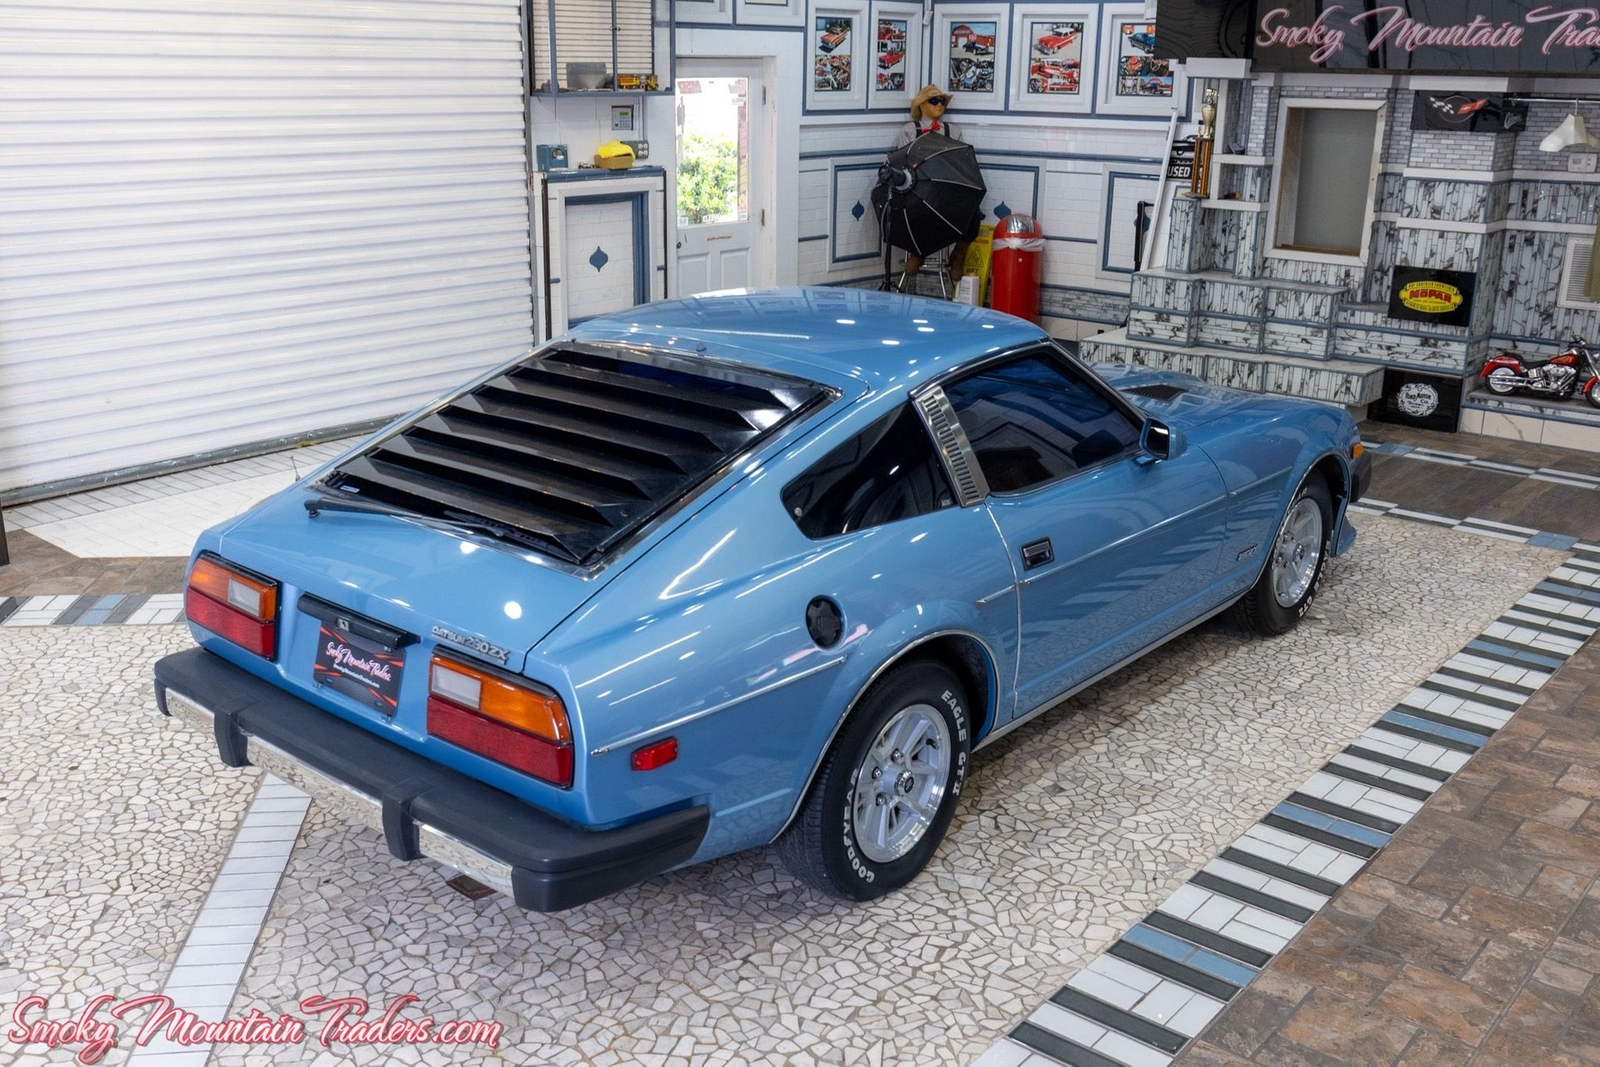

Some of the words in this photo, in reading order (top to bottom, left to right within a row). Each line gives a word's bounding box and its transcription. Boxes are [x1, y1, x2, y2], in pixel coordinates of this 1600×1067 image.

[1256, 5, 1346, 63] Smoky
[1350, 5, 1524, 52] Mountain
[1525, 5, 1600, 55] Tra
[1167, 165, 1191, 178] USED
[1409, 289, 1452, 304] MOPAR
[432, 625, 466, 645] DATSUN
[941, 689, 967, 742] EAGLE
[843, 767, 875, 884] GOODYEAR
